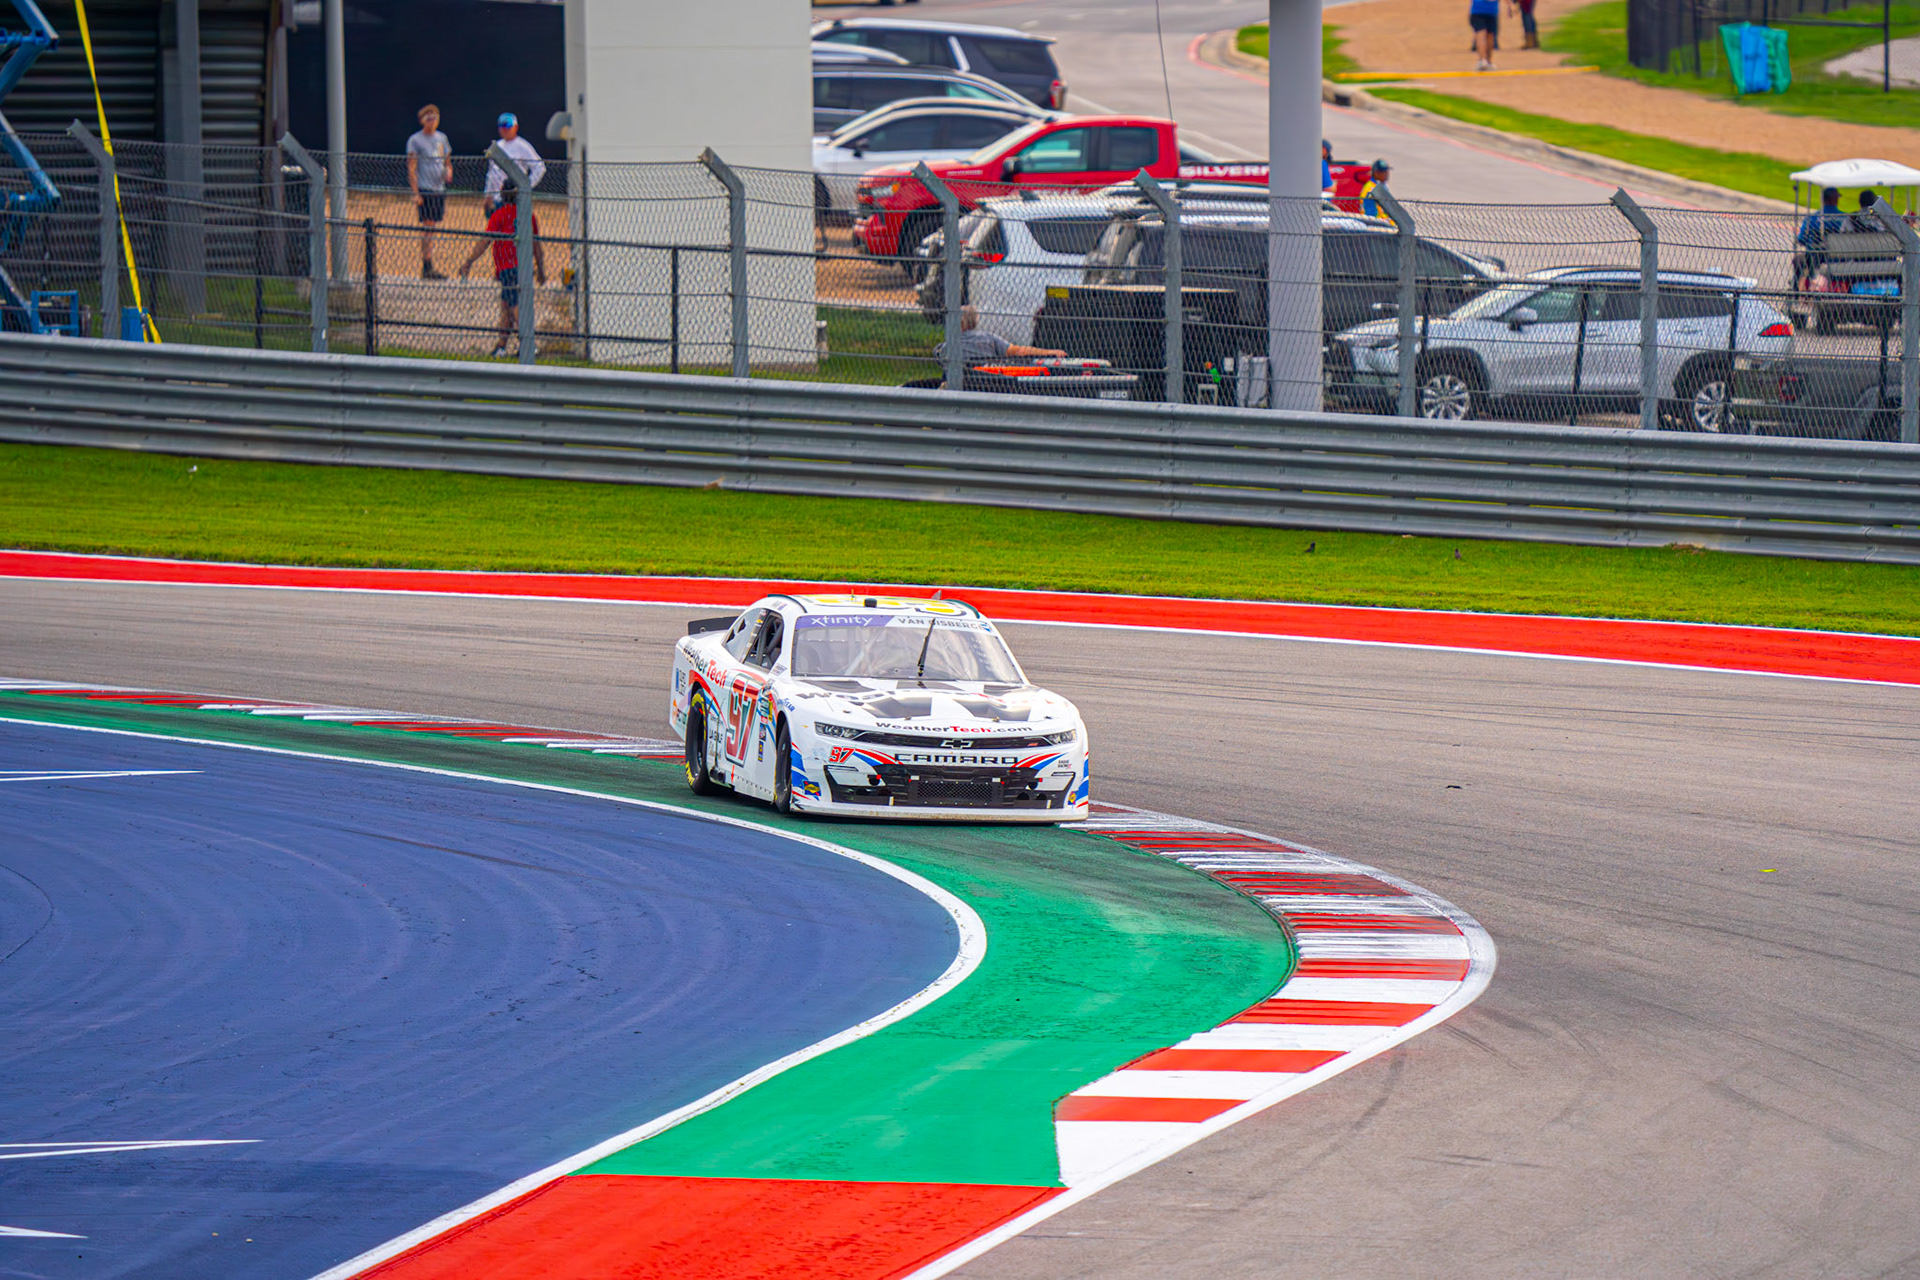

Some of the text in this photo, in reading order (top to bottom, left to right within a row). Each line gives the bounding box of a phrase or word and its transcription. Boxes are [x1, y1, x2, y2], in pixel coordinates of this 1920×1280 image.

[811, 616, 873, 627] xfinity
[898, 617, 925, 626] VAN
[726, 674, 763, 768] 97
[875, 721, 1033, 734] WeatherTech.com
[829, 746, 855, 764] 97
[894, 753, 1018, 765] CAMARO
